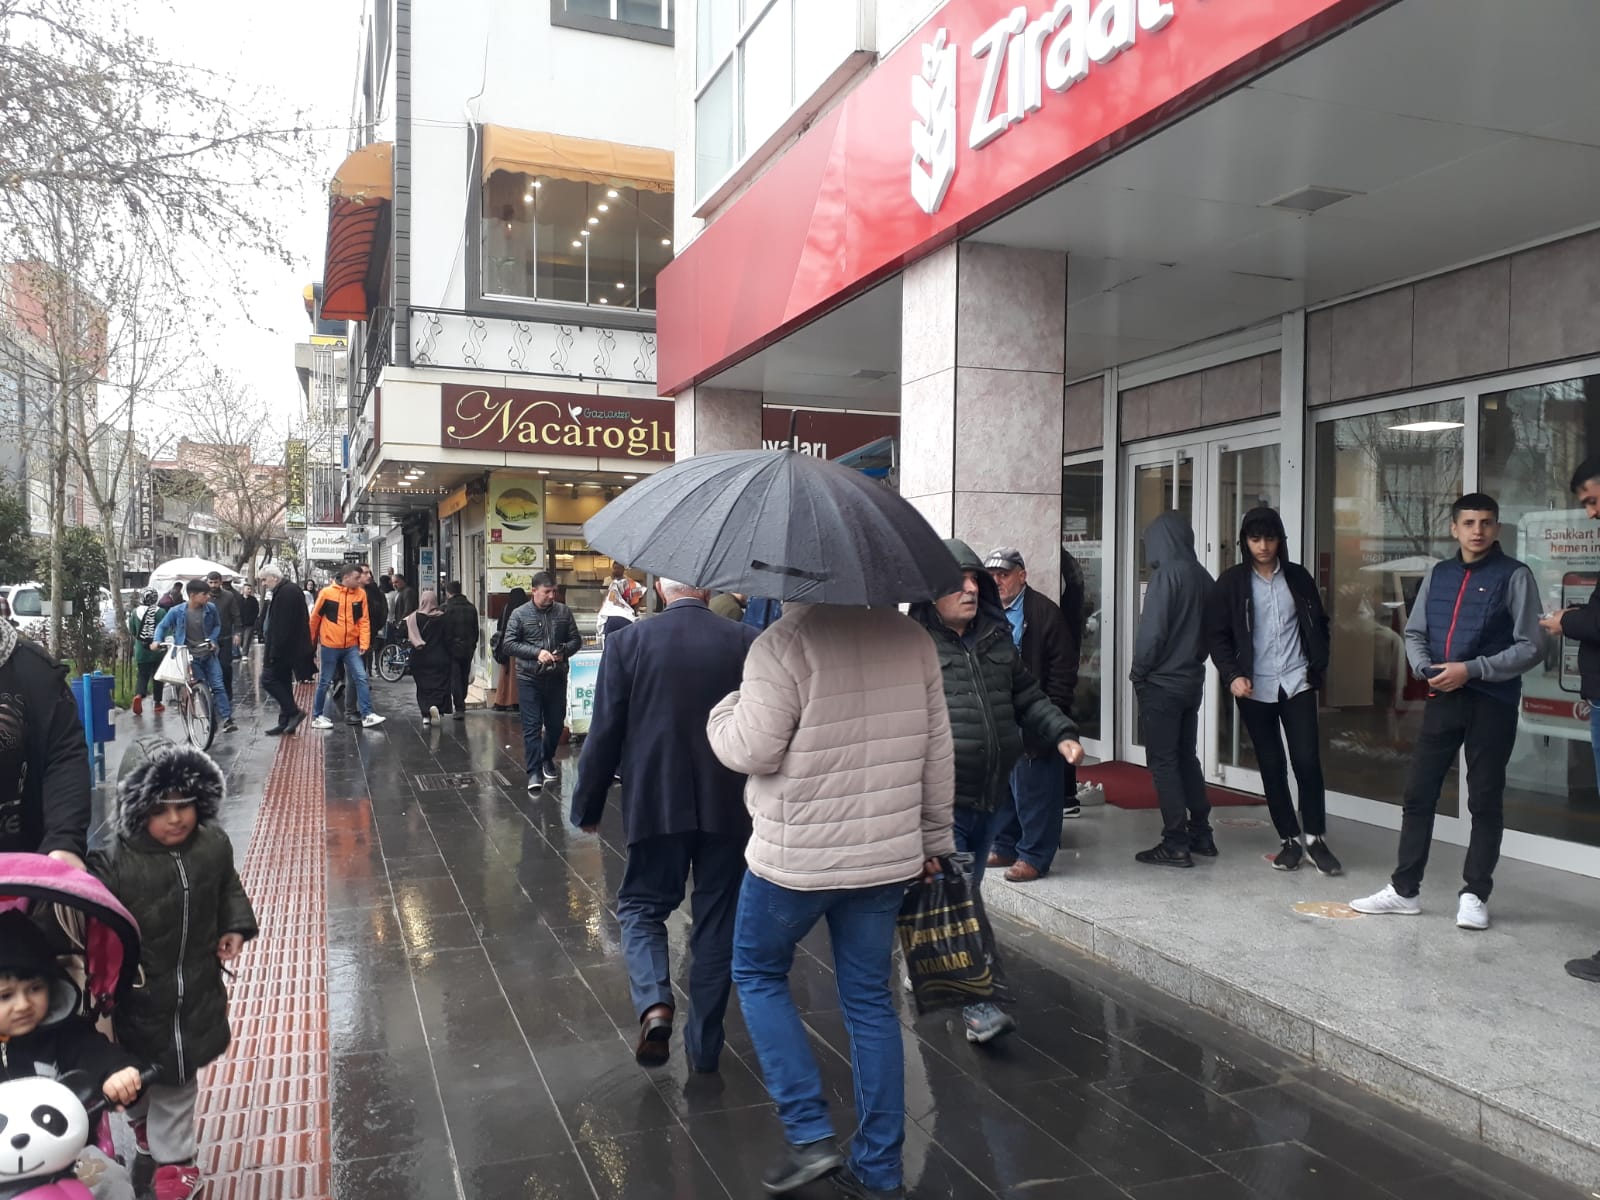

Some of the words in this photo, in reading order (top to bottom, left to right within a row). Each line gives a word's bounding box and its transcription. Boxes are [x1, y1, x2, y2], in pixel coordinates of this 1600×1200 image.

[447, 390, 675, 457] Nacaroğlu
[1544, 528, 1593, 540] Bankkart
[1551, 541, 1588, 553] hemen
[577, 688, 596, 698] Be
